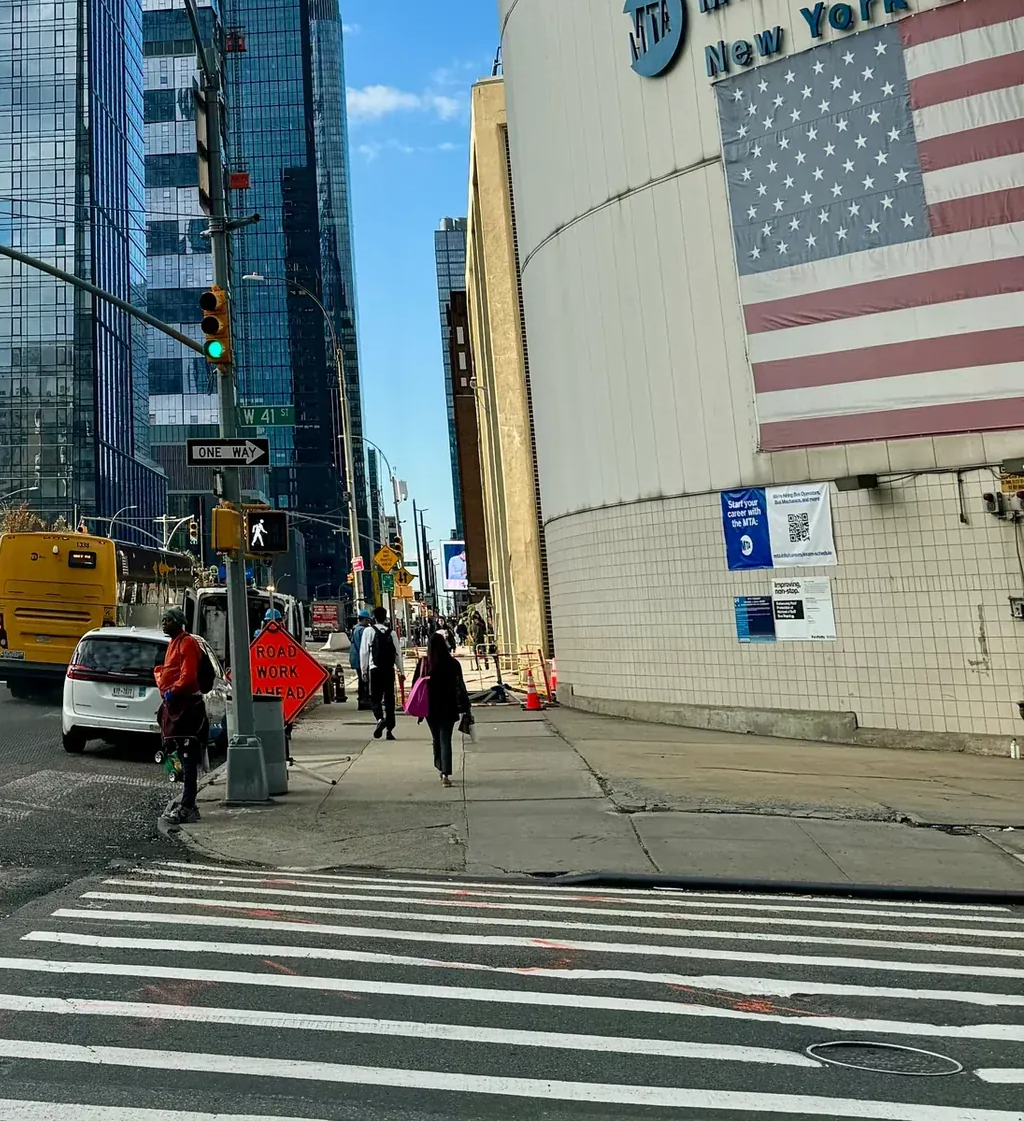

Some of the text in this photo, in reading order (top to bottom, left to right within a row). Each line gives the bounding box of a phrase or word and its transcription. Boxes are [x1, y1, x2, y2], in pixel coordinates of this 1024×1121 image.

[629, 0, 672, 62] MTA
[704, 26, 784, 77] New
[243, 408, 289, 424] W 41 ST
[198, 446, 257, 458] ONE WAY
[727, 499, 758, 509] Start your
[727, 508, 761, 518] career with
[732, 518, 759, 528] the MTA:
[774, 581, 802, 589] Improving,
[256, 645, 297, 659] ROAD
[257, 666, 299, 678] WORK
[256, 686, 306, 700] AHEAD
